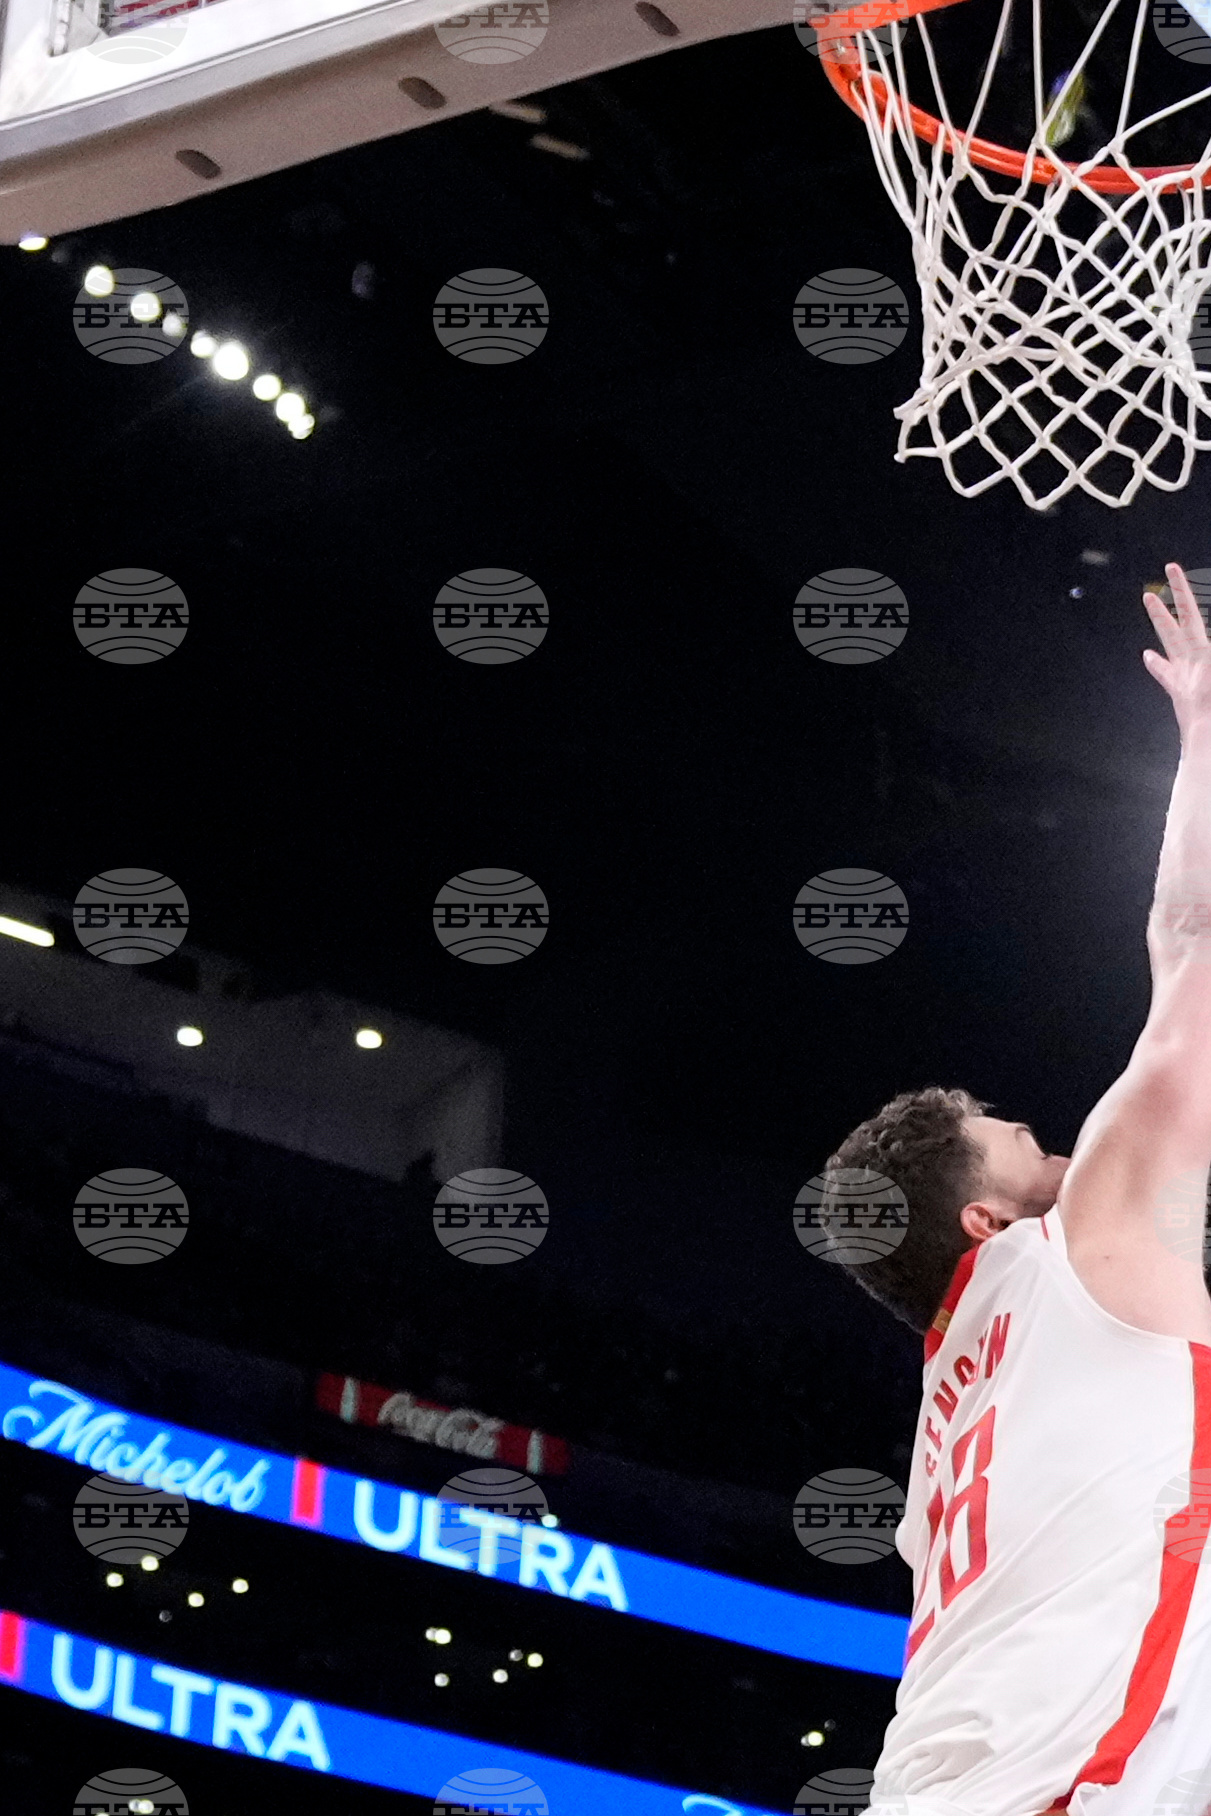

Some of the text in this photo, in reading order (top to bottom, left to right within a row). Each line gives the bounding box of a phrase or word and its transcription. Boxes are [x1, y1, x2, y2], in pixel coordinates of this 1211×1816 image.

[2, 1379, 629, 1612] Michelob ULTRA
[51, 1631, 331, 1772] ULTRA
